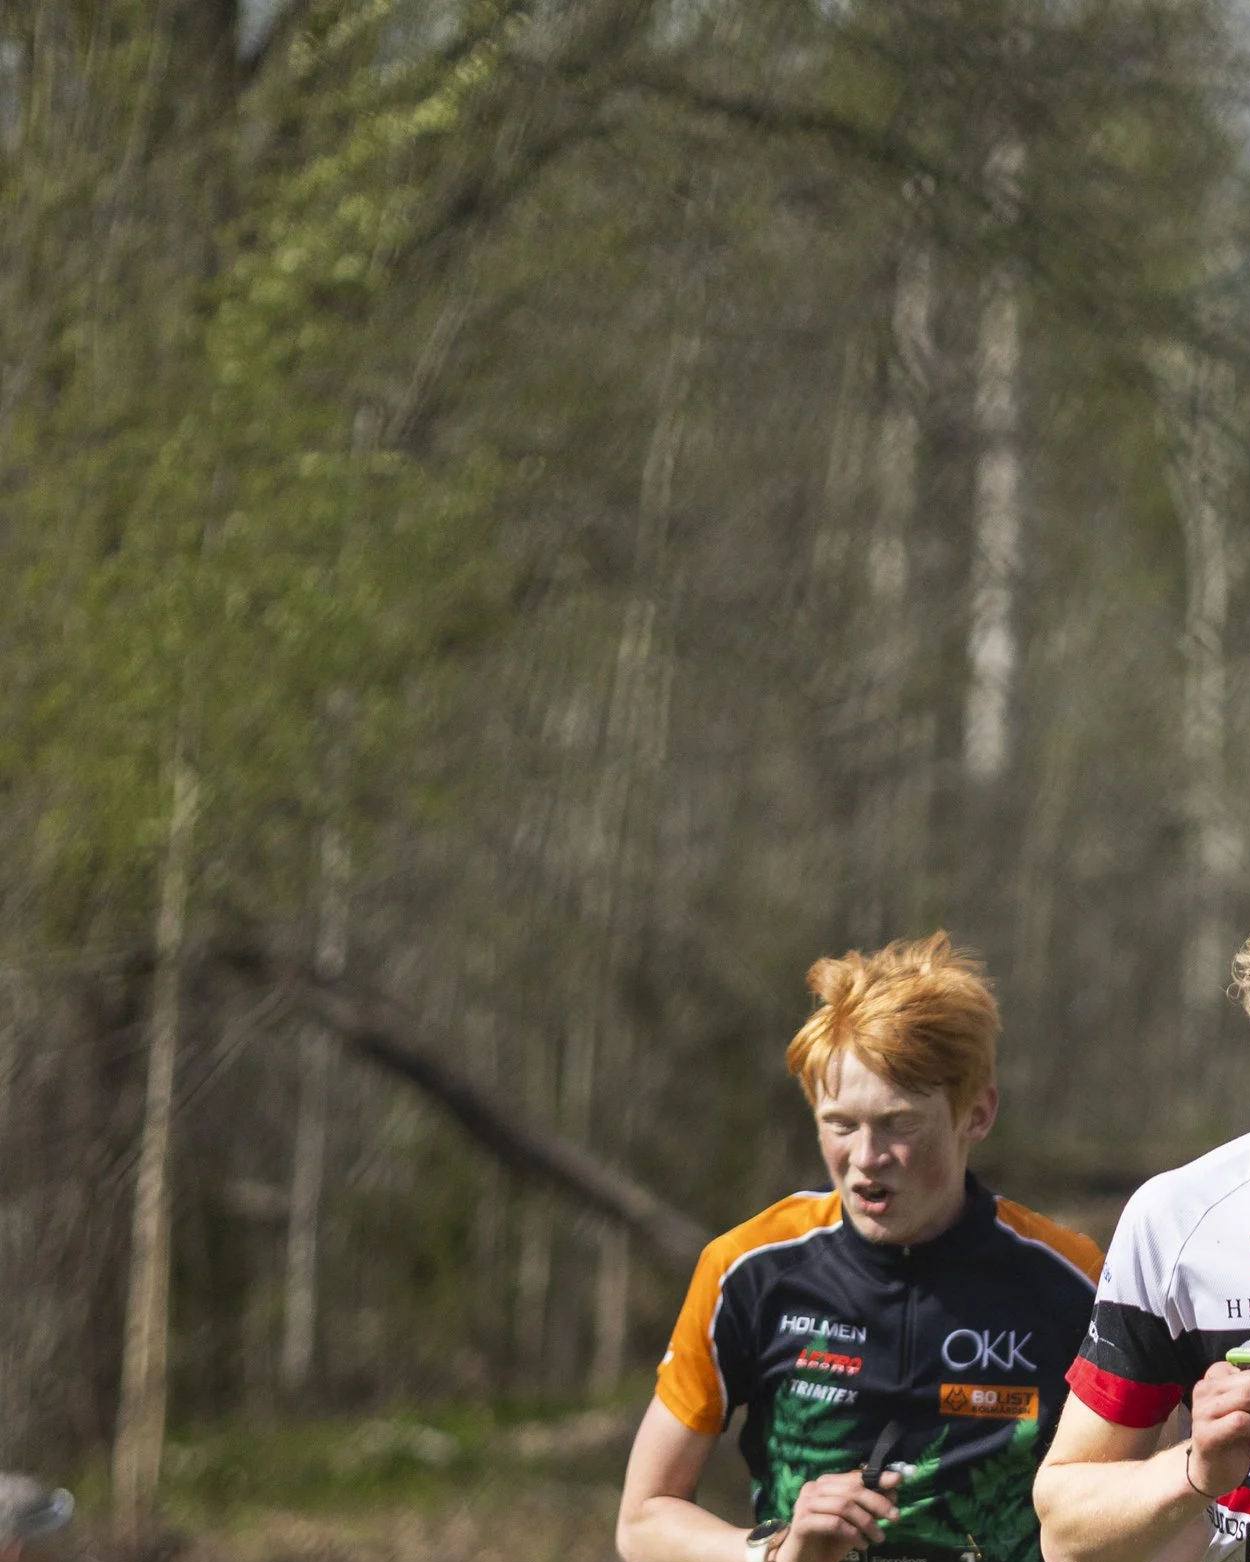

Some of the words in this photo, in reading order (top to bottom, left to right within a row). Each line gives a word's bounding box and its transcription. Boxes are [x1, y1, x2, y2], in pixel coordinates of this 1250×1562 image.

[780, 1315, 867, 1343] HOLMEN
[942, 1329, 1037, 1371] OKK
[790, 1379, 858, 1404] TRIMTEX
